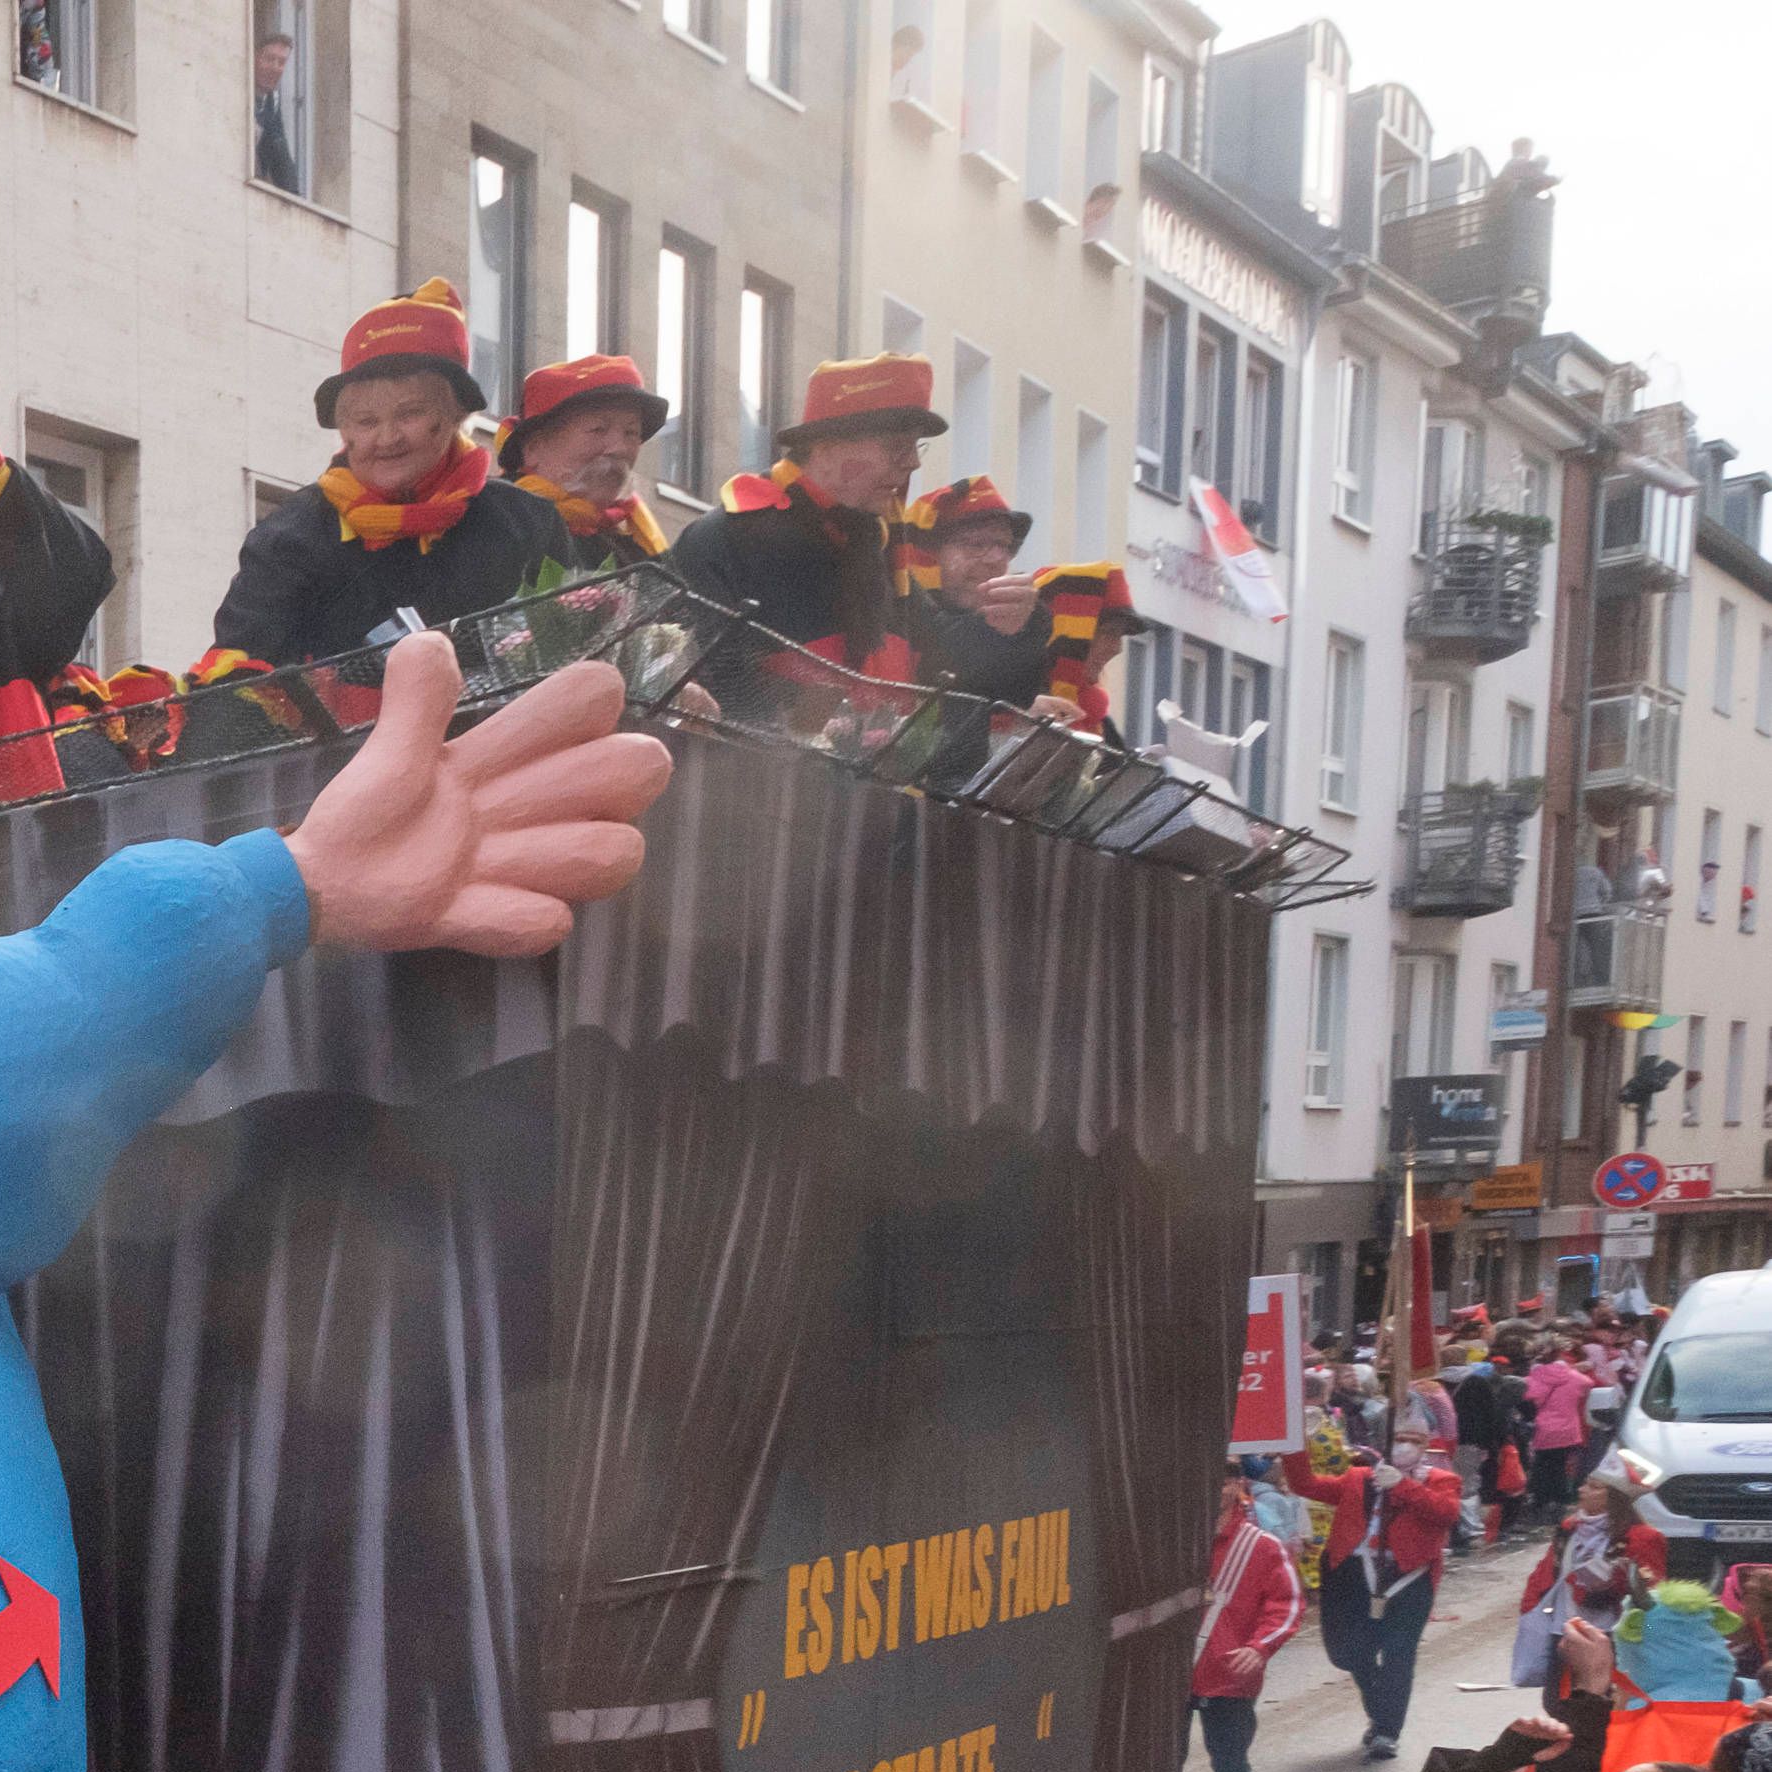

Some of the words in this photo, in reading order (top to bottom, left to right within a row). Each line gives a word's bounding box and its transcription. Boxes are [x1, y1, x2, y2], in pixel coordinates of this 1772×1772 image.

[784, 1555, 835, 1680] ES
[841, 1541, 909, 1664] IST
[914, 1522, 995, 1644] WAS
[998, 1507, 1071, 1623] FAUL
